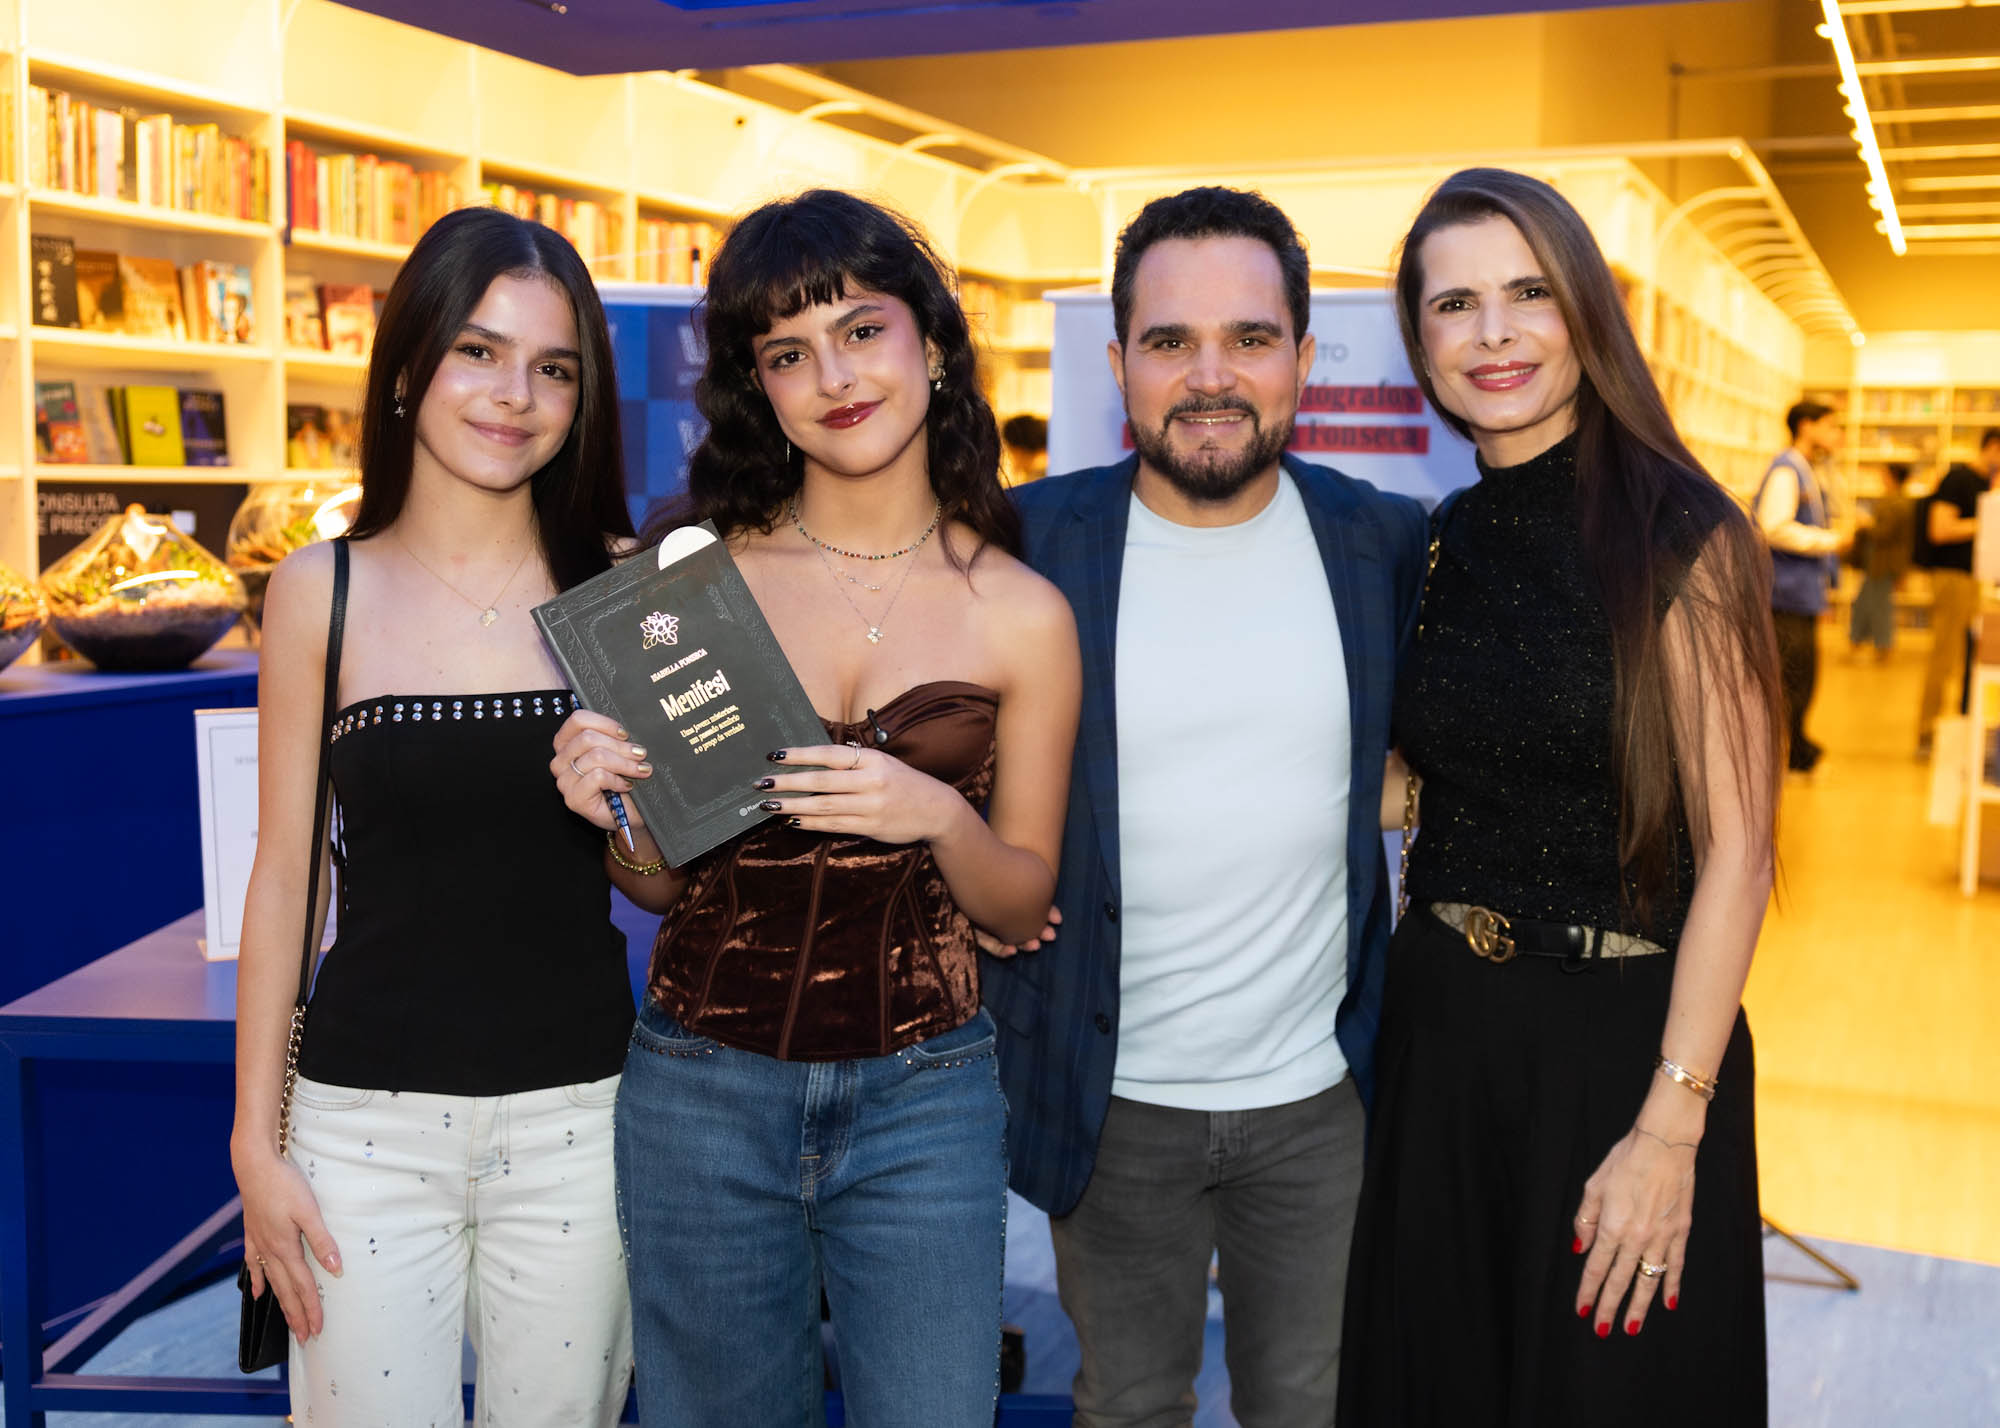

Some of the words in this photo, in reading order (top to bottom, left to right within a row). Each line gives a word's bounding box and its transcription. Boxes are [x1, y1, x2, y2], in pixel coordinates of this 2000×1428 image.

[1303, 377, 1418, 412] tógrafos
[1309, 418, 1418, 447] Fonseca
[38, 493, 120, 512] ONSULTA
[650, 662, 680, 683] ISABELLA
[678, 648, 708, 668] FONSECA
